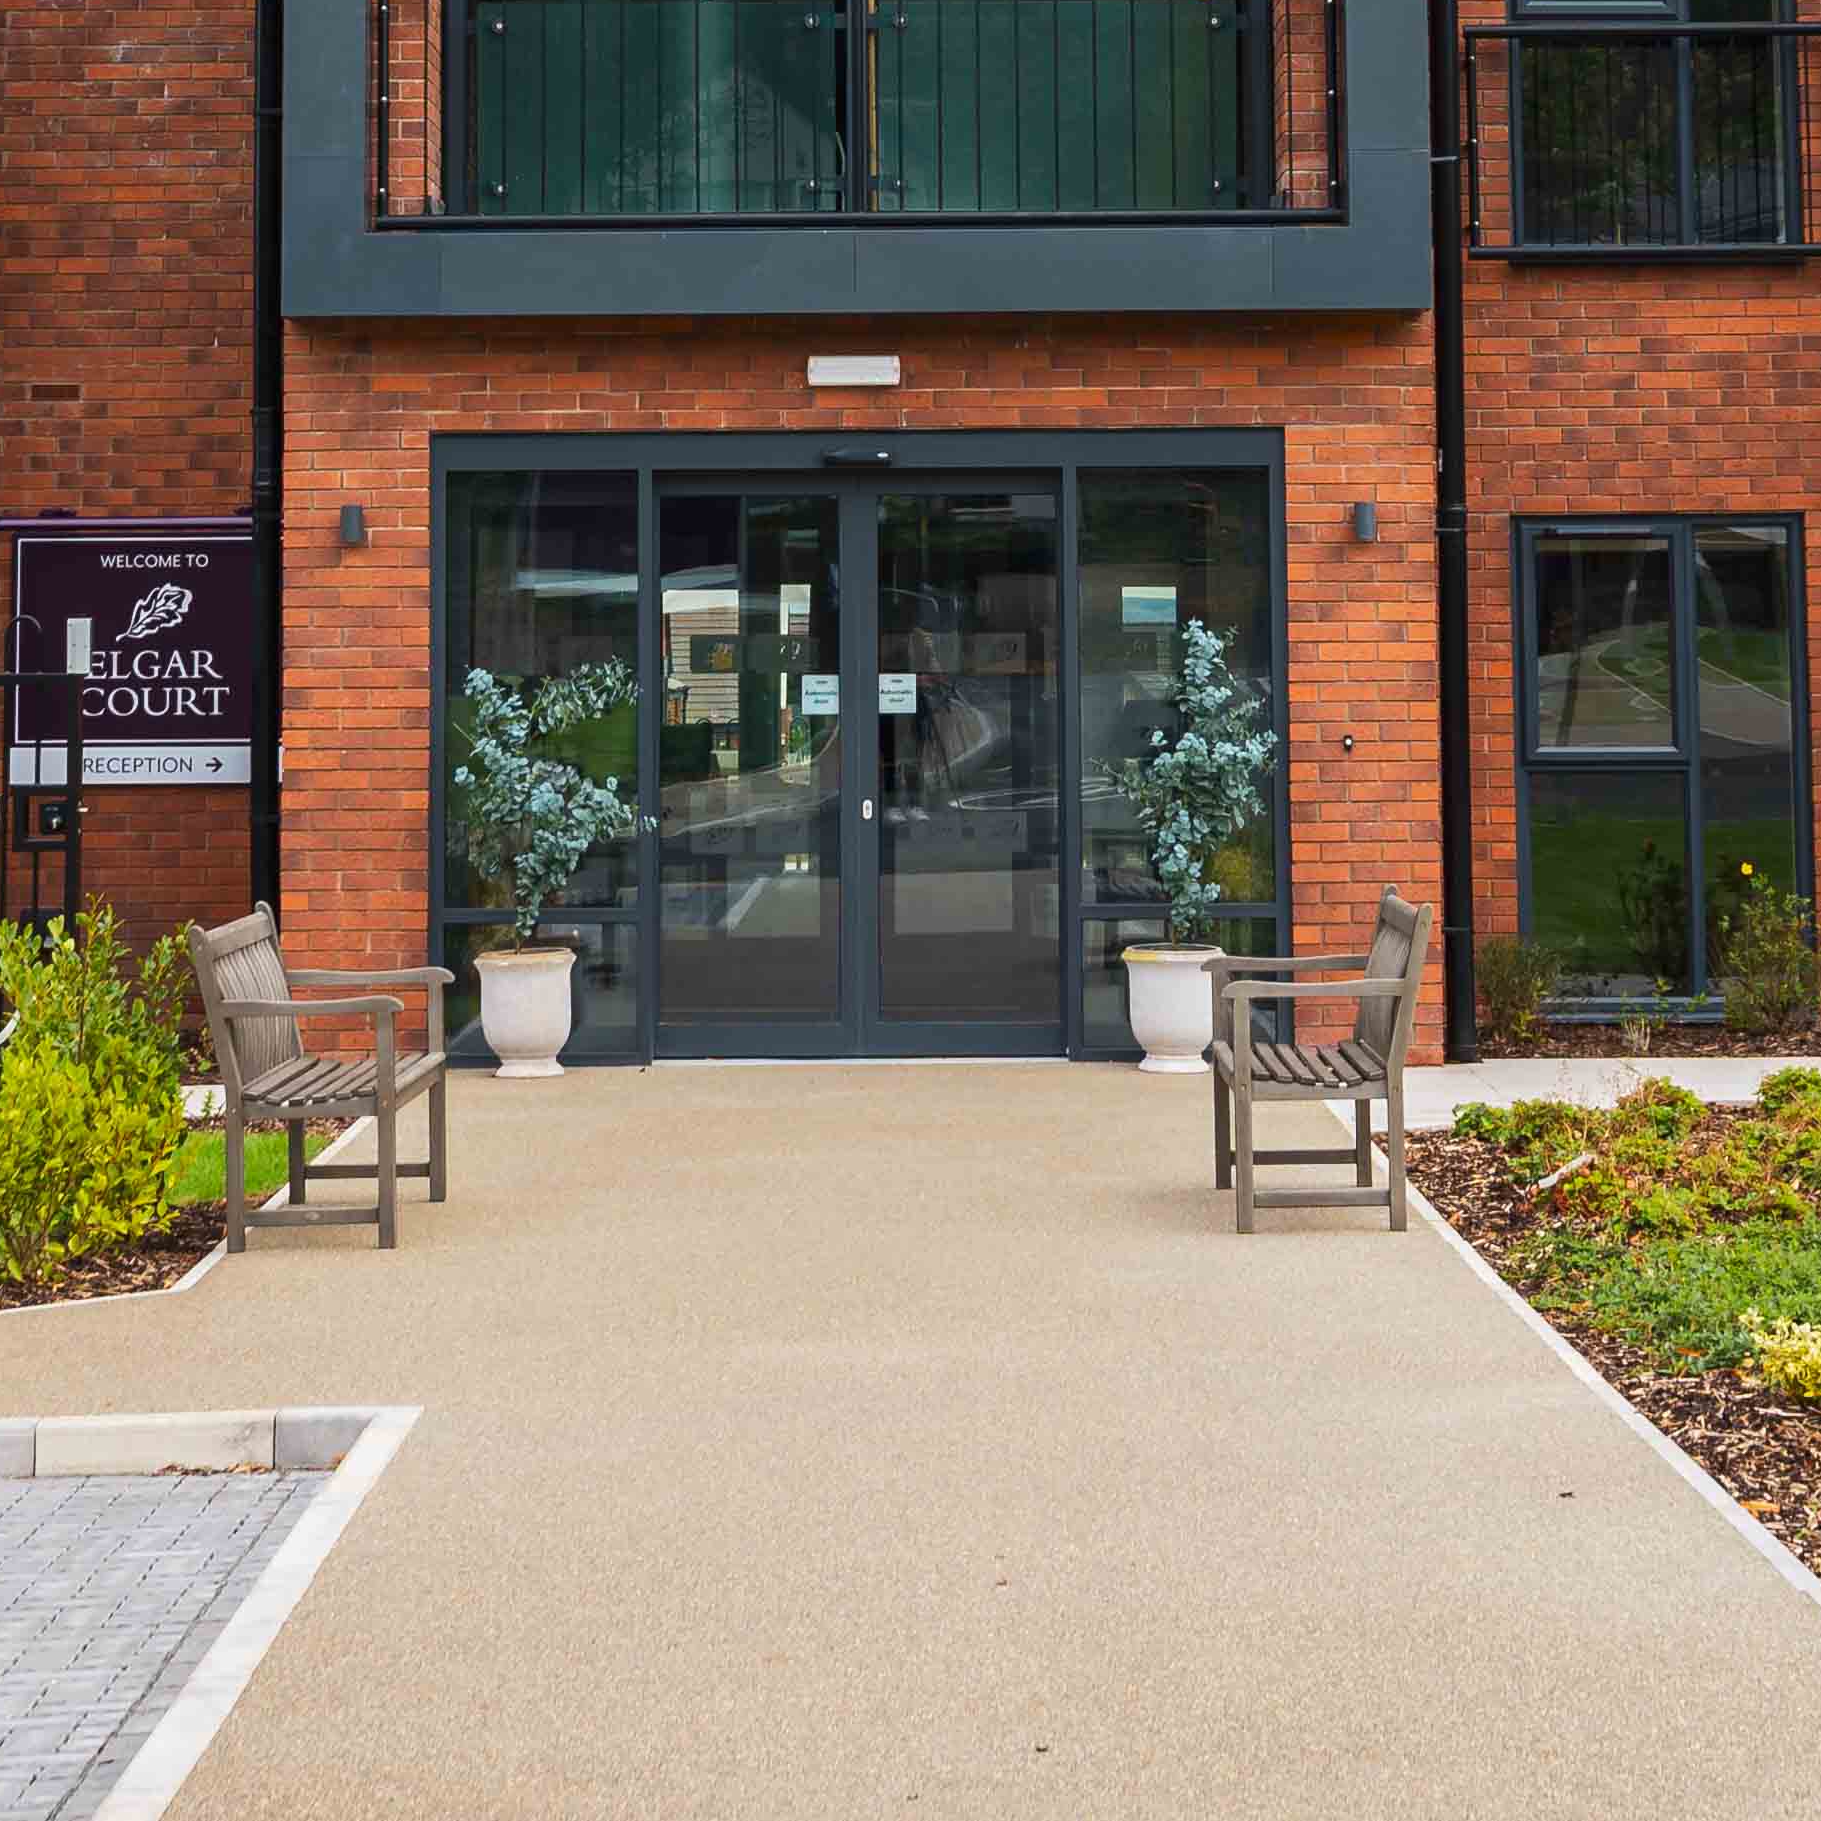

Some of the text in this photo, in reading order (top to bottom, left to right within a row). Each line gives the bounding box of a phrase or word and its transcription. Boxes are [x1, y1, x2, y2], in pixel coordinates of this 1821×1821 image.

[100, 554, 209, 568] WELCOME TO
[84, 650, 223, 680] ELGAR
[82, 687, 230, 717] COURT
[83, 757, 193, 773] RECEPTION
